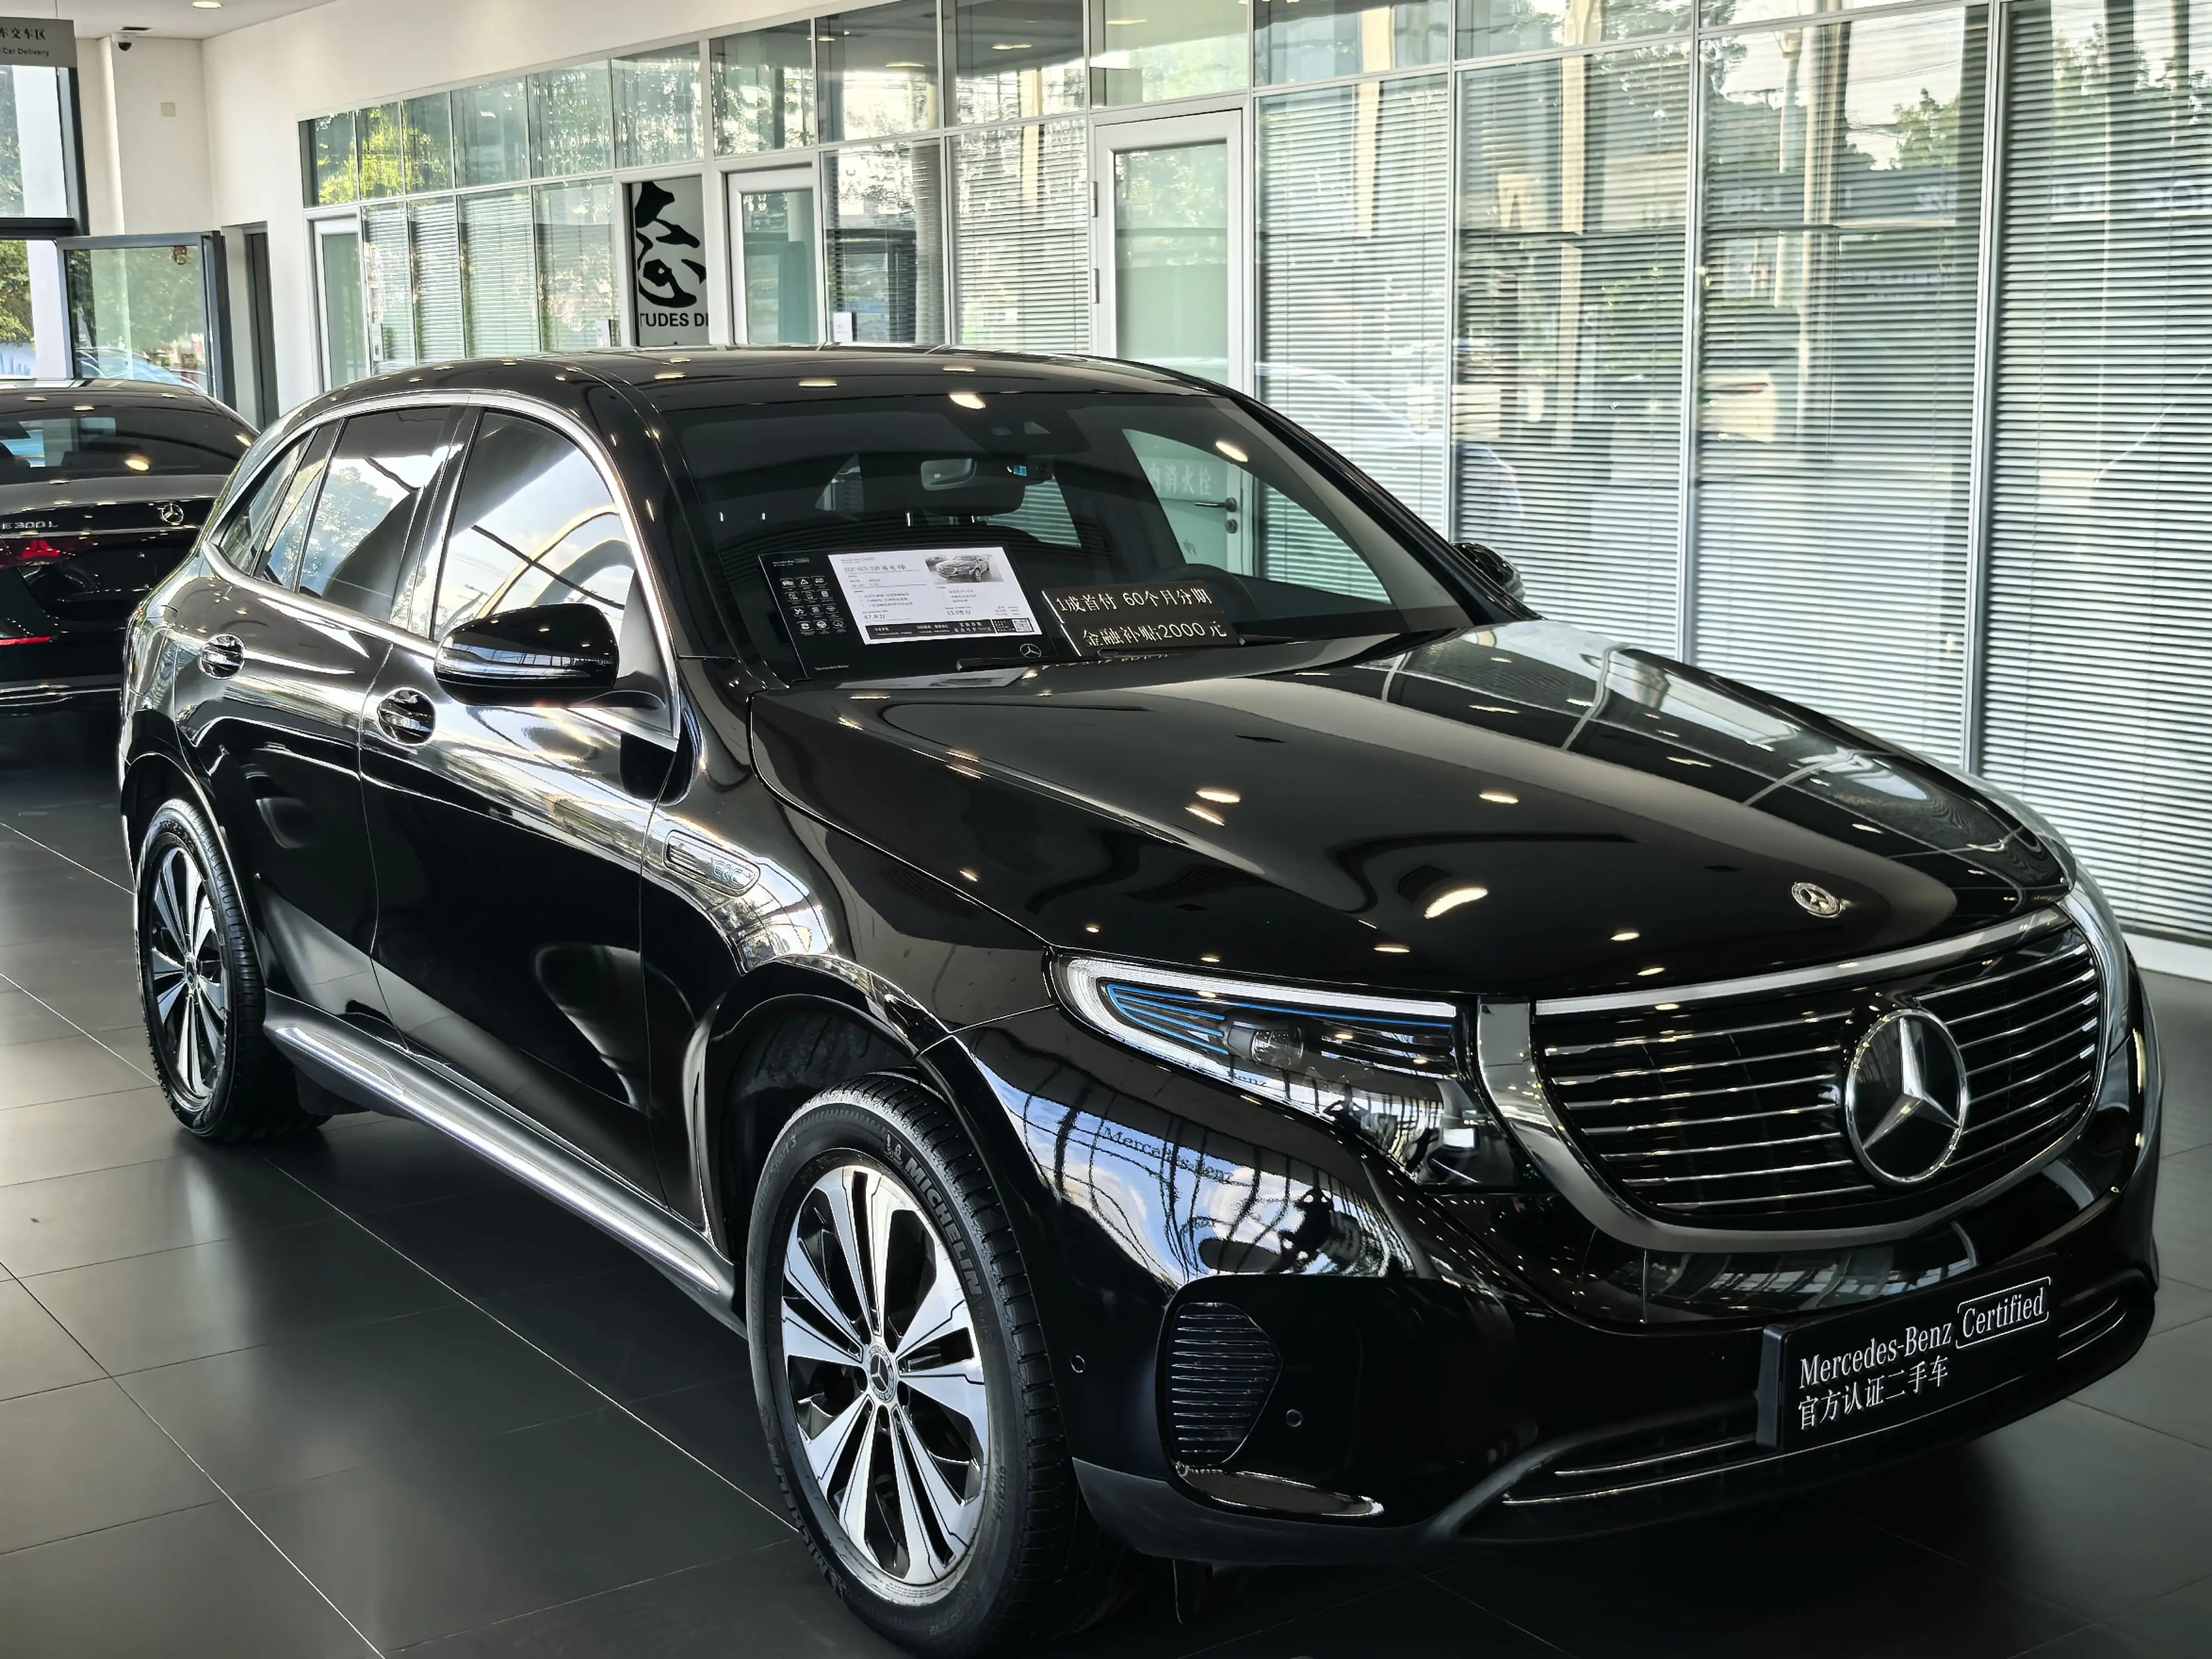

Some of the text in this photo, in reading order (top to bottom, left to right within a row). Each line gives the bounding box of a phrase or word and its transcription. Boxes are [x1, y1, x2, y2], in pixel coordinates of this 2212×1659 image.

[17, 48, 49, 58] Delivery
[1056, 587, 1212, 612] 1成首付 60个月分期
[790, 1134, 797, 1148] 3
[905, 1157, 982, 1296] MICHELIN
[1798, 1287, 2044, 1390] Mercedes-Benz Certified
[1798, 1355, 1949, 1431] 官方认证二手车
